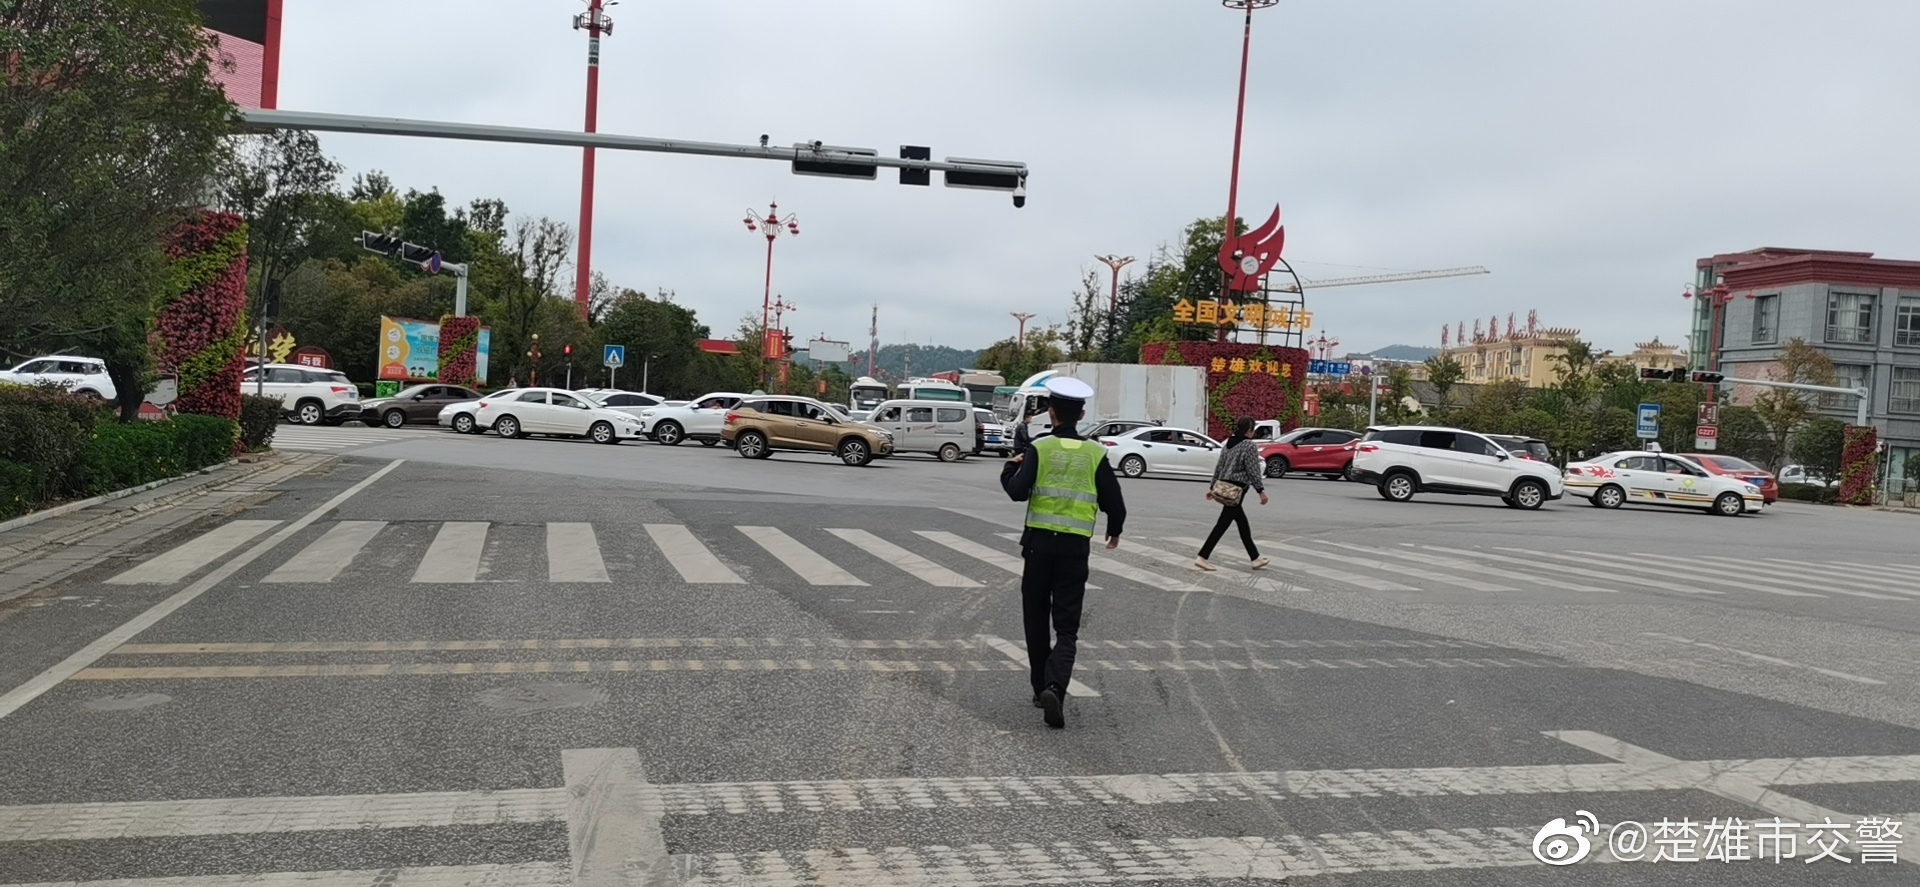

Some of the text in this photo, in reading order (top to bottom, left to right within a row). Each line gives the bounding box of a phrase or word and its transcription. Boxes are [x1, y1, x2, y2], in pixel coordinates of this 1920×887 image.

[1172, 298, 1314, 331] 全国文明城市
[1211, 356, 1292, 378] 楚雄欢迎您
[1699, 428, 1715, 436] G227
[1046, 473, 1090, 489] POLICE
